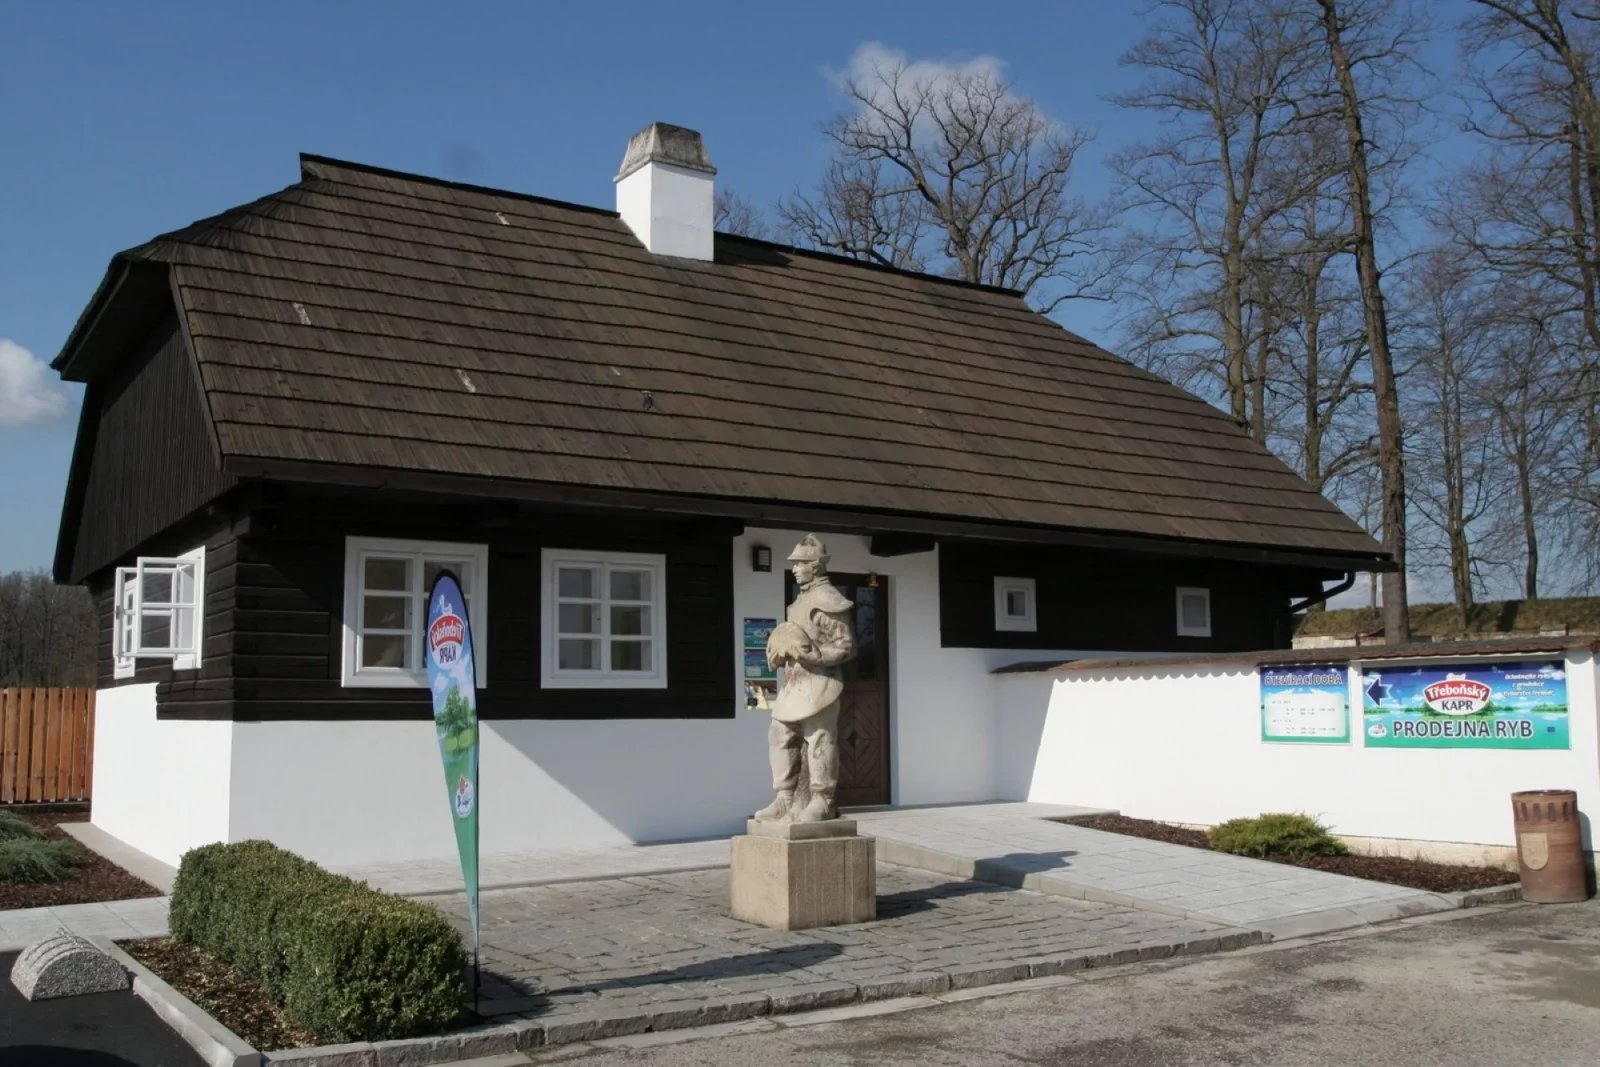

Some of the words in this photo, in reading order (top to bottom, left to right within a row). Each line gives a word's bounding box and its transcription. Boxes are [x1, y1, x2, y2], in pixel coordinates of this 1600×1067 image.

[1427, 683, 1487, 700] Třeboňský
[1442, 700, 1473, 711] KAPR
[1393, 720, 1490, 737] PRODEJNA
[1496, 720, 1533, 737] RYB
